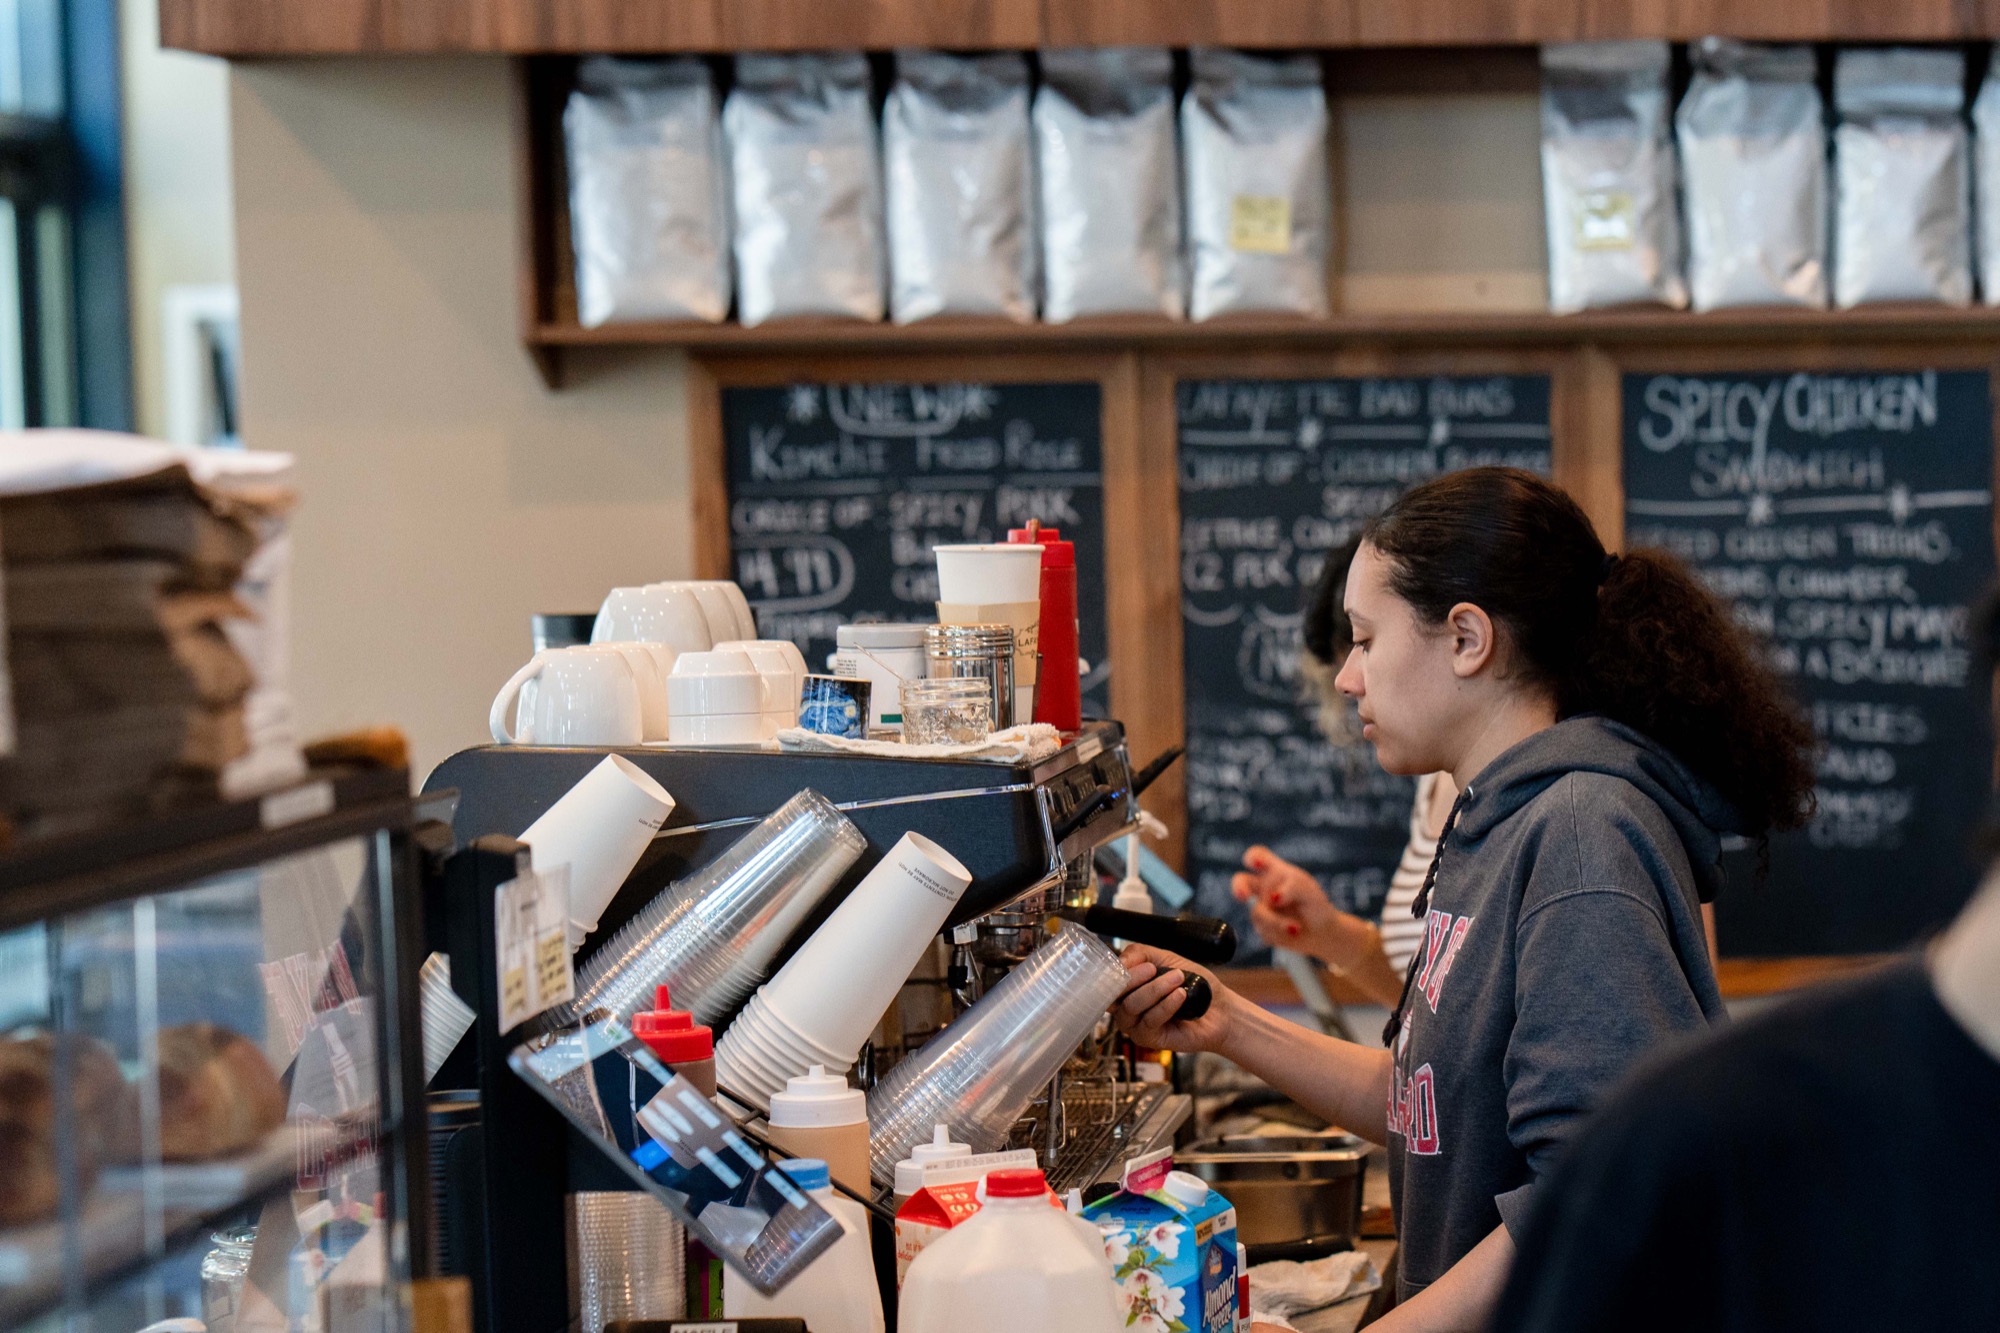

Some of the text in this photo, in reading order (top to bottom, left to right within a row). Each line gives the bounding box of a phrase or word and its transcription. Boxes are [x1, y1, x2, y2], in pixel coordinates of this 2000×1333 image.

[1637, 368, 1938, 474] SPICY CHICKEN
[906, 869, 914, 877] BE
[913, 874, 924, 884] MAY
[914, 867, 940, 888] MICROWAVE
[923, 882, 946, 898] CONTENTS
[939, 884, 949, 893] NOT
[1202, 1264, 1237, 1328] Almond
